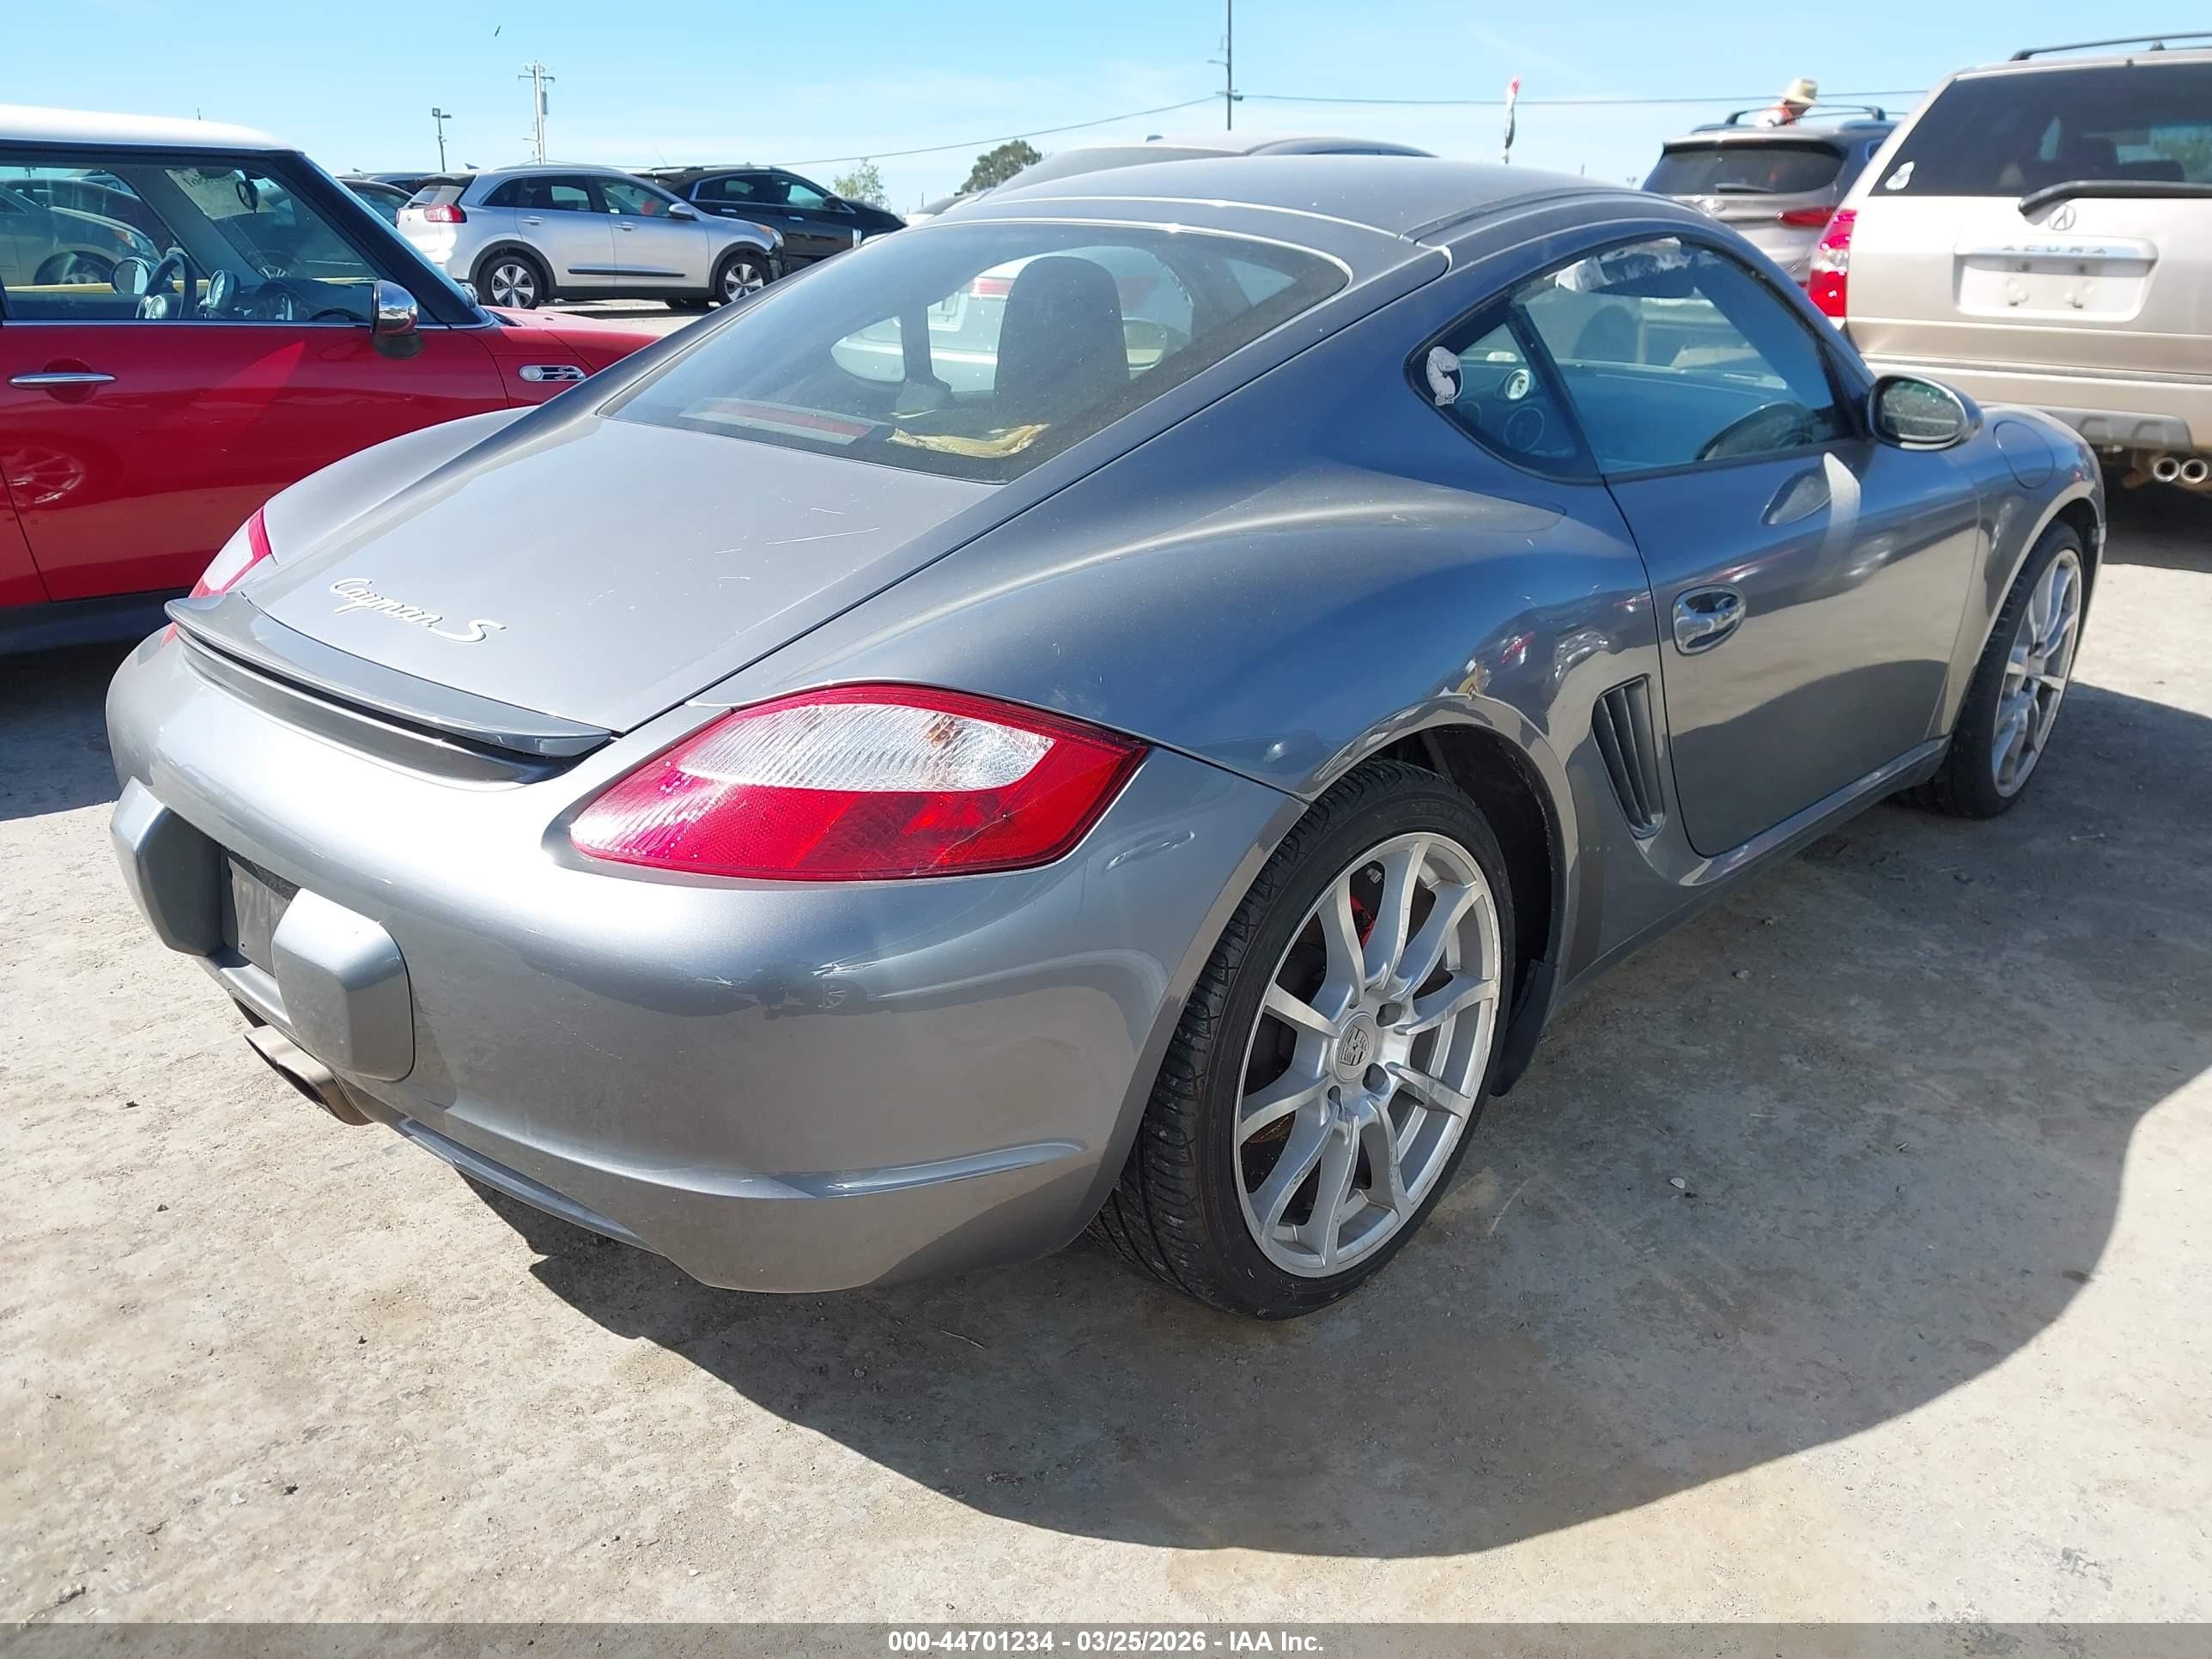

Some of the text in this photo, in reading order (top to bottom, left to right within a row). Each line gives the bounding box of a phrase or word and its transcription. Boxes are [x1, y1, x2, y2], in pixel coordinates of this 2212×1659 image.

[2001, 245, 2108, 255] ACURA
[330, 577, 508, 643] Cayman S
